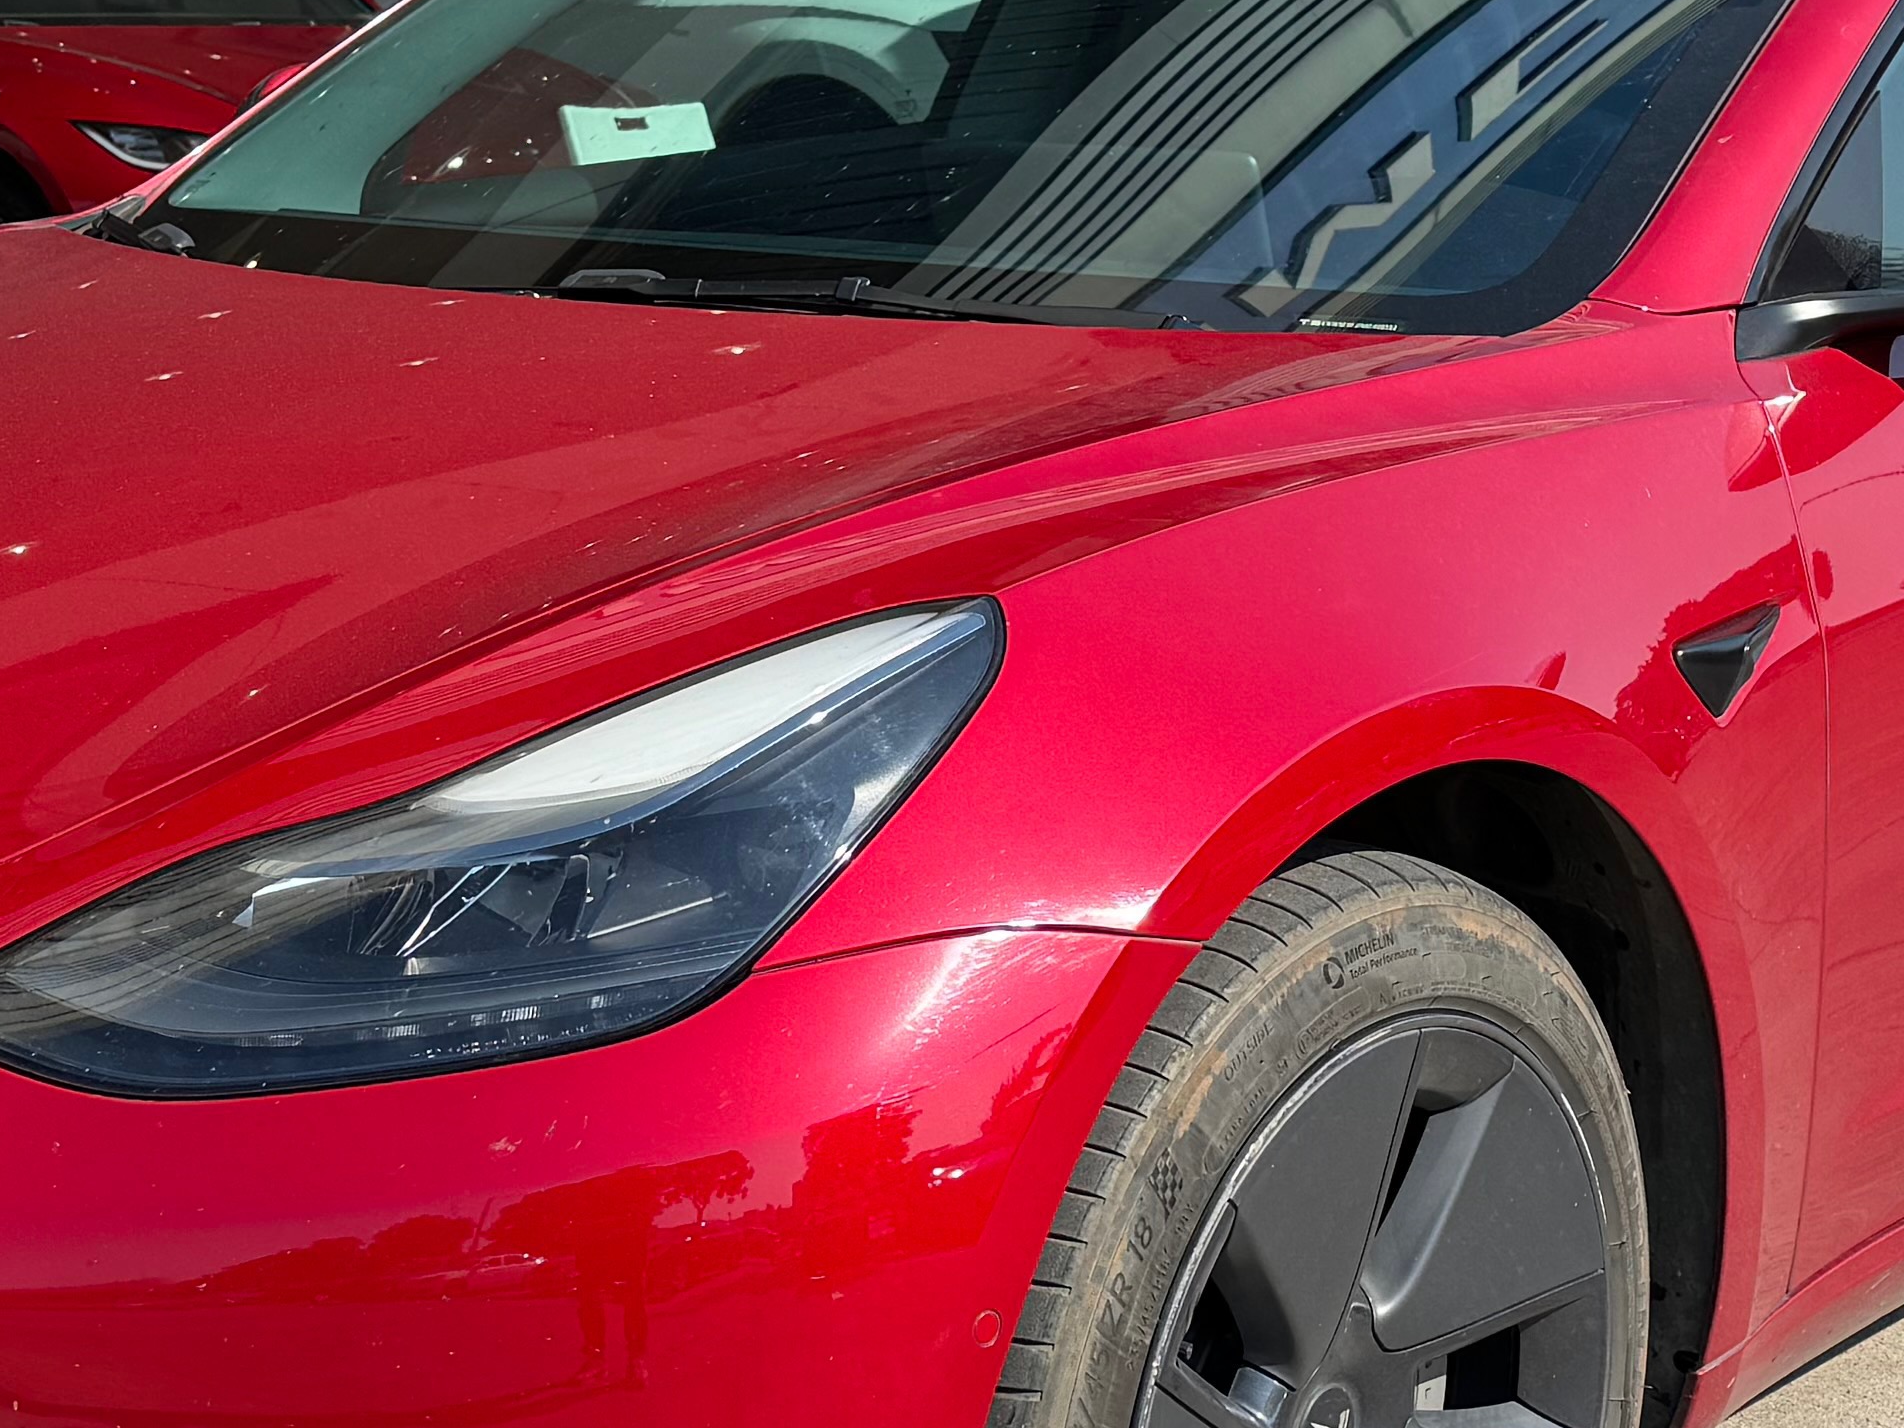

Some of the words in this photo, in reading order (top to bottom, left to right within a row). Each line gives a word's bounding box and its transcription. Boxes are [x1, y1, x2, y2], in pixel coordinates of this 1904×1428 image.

[1345, 933, 1395, 965] MICHELIN
[1349, 962, 1369, 979] Total
[1370, 947, 1417, 969] Performance
[1223, 1022, 1274, 1081] OUTSIDE
[1101, 1272, 1133, 1338] ZR
[1127, 1217, 1154, 1262] 18
